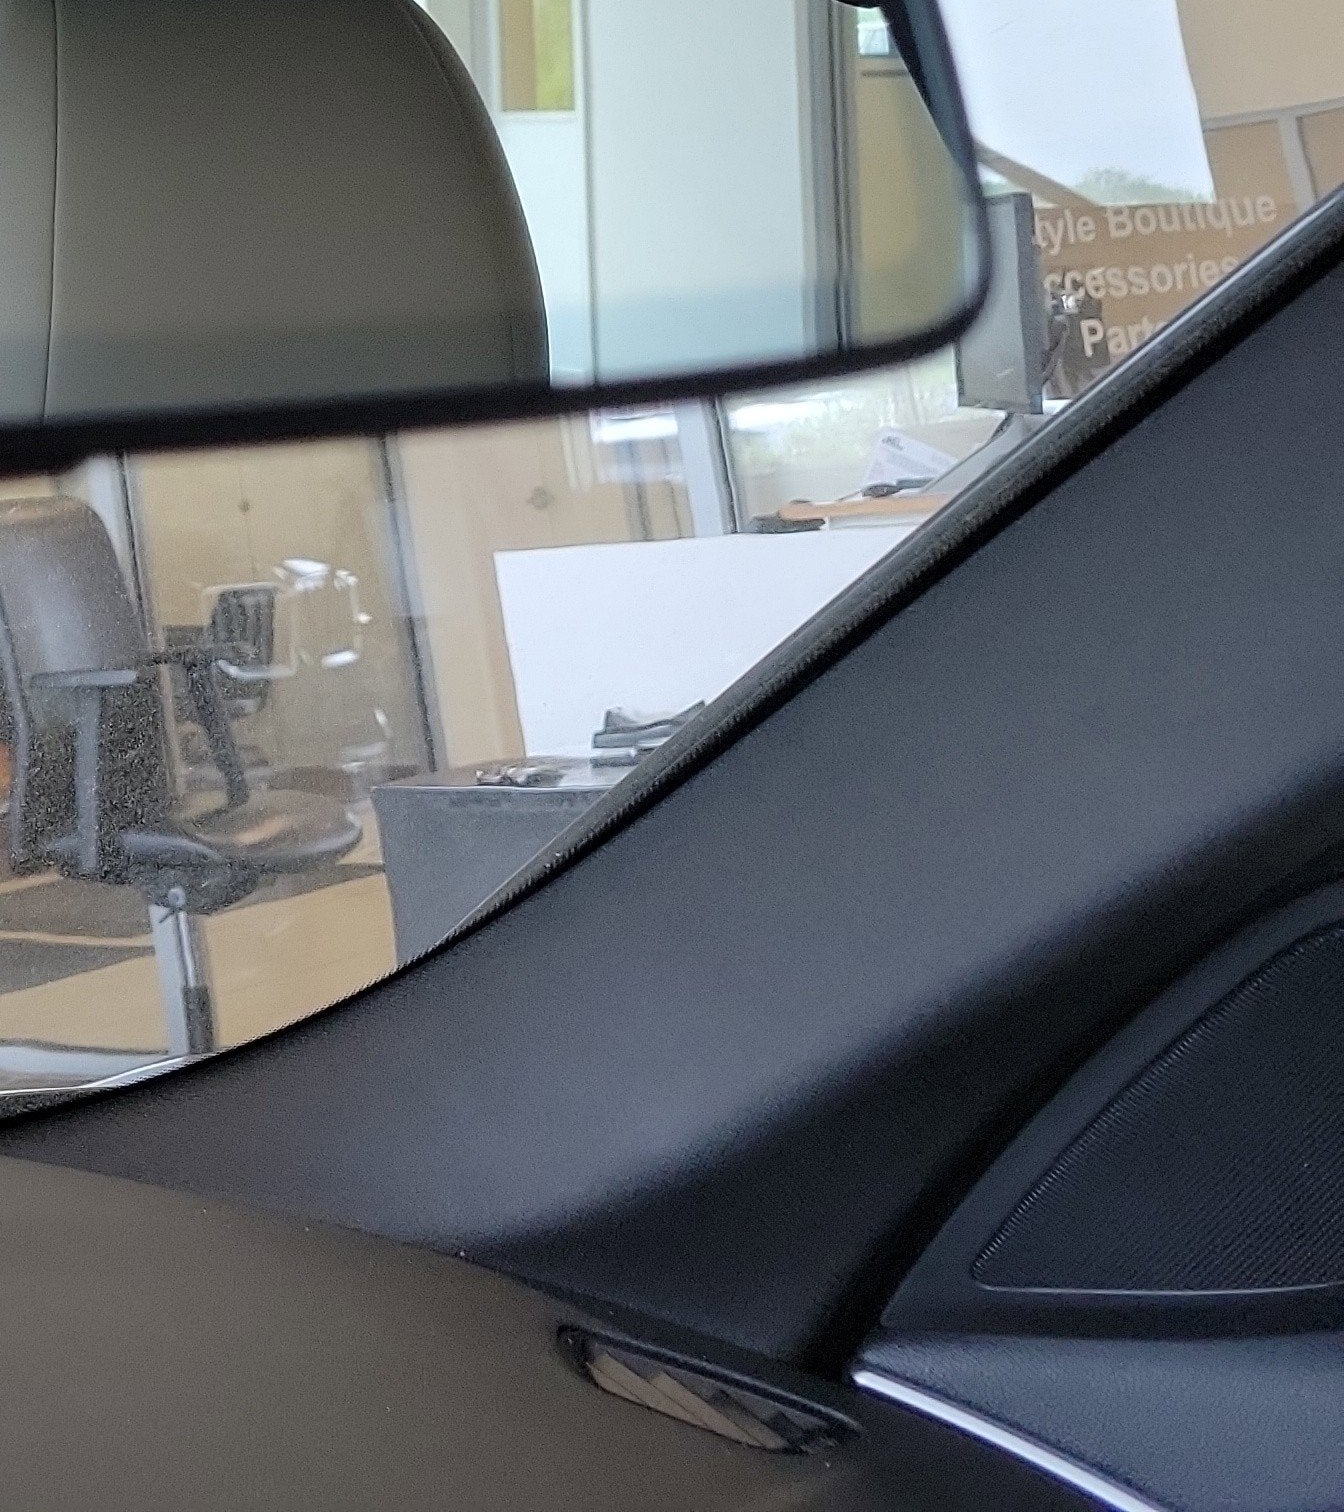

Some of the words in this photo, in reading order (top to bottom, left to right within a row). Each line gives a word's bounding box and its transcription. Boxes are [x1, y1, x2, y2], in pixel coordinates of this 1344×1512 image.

[1033, 207, 1097, 256] tyle
[1106, 194, 1278, 238] Boutique
[1043, 254, 1240, 300] ccessorie
